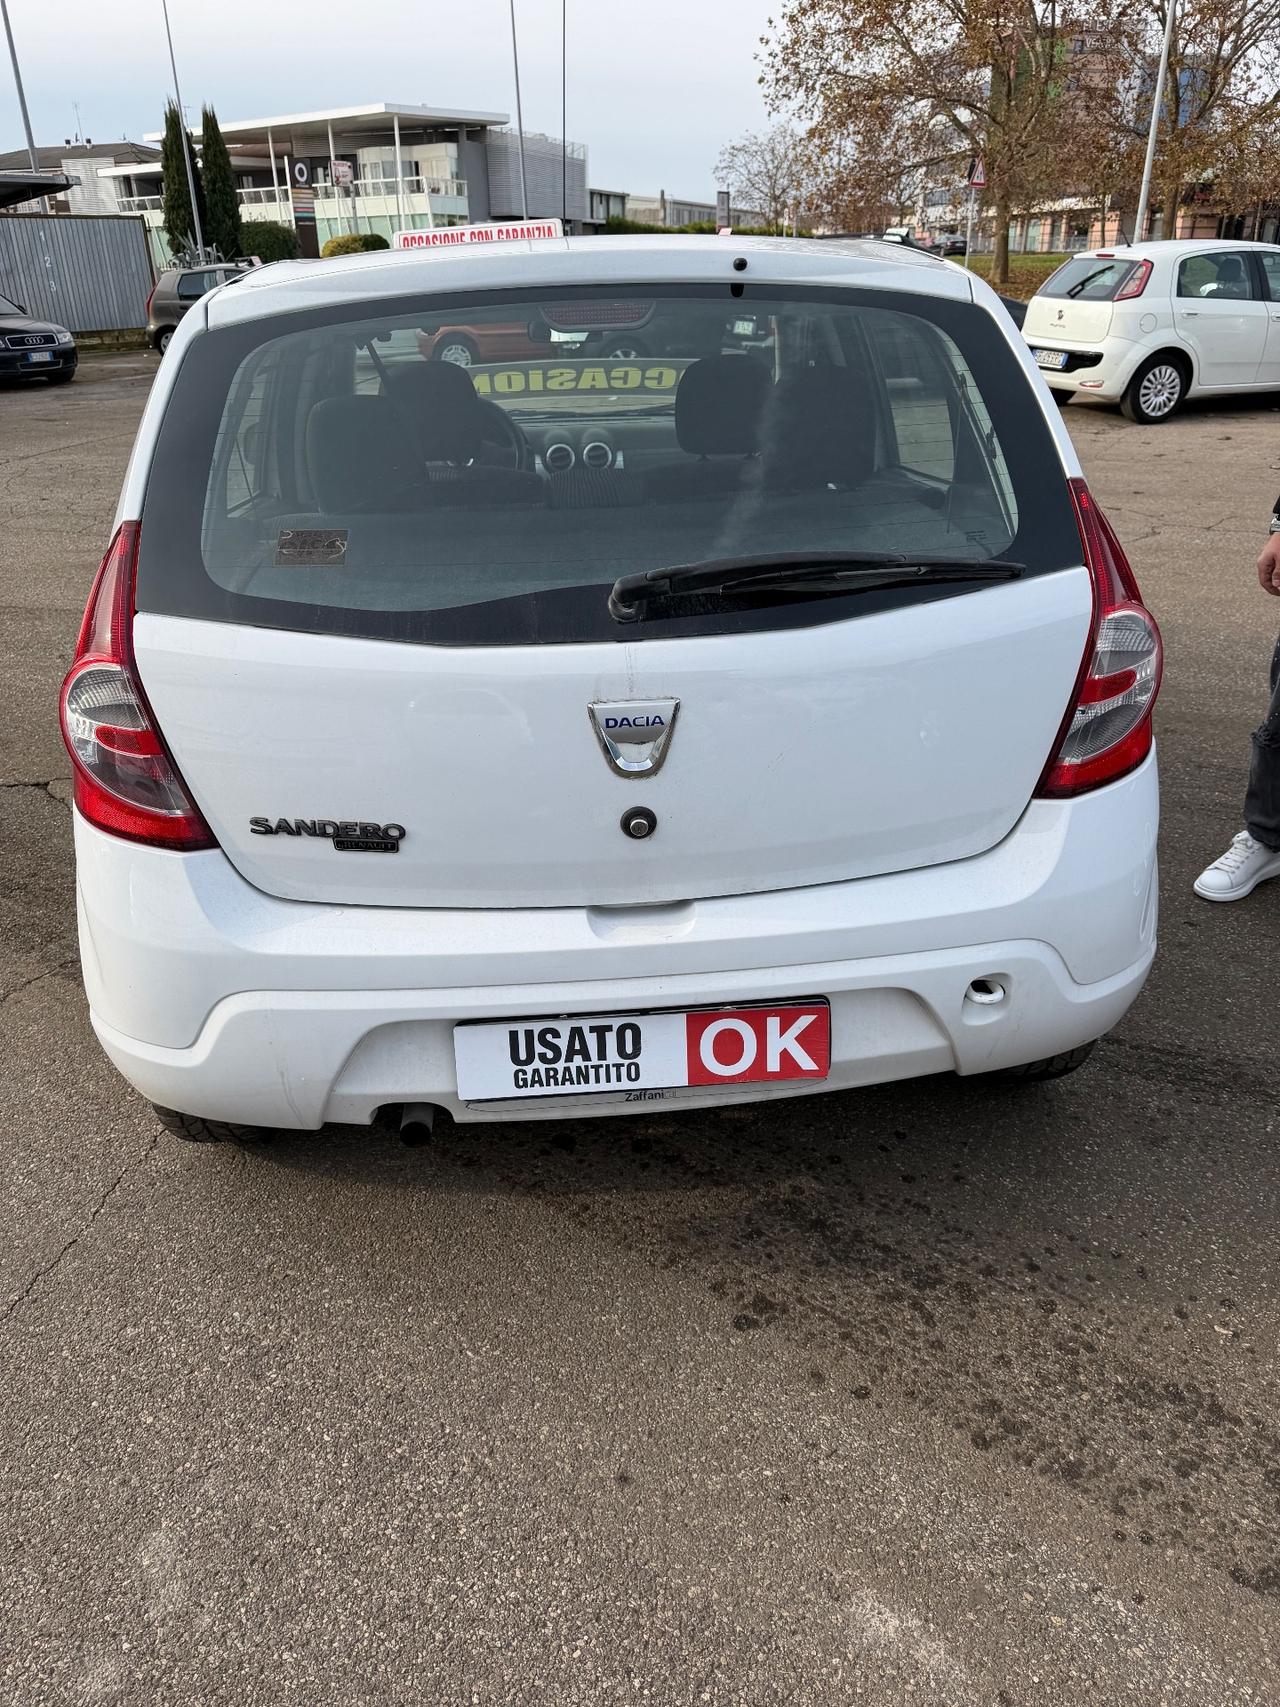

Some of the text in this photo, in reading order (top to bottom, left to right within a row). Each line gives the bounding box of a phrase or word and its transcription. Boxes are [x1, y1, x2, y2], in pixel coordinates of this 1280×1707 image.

[39, 230, 45, 241] 1
[44, 256, 52, 268] 2
[49, 280, 57, 292] 3
[605, 715, 665, 729] DACIA
[249, 816, 406, 840] SANDERO
[509, 1023, 642, 1067] USATO
[698, 1013, 820, 1077] OK
[513, 1061, 641, 1090] GARANTITO
